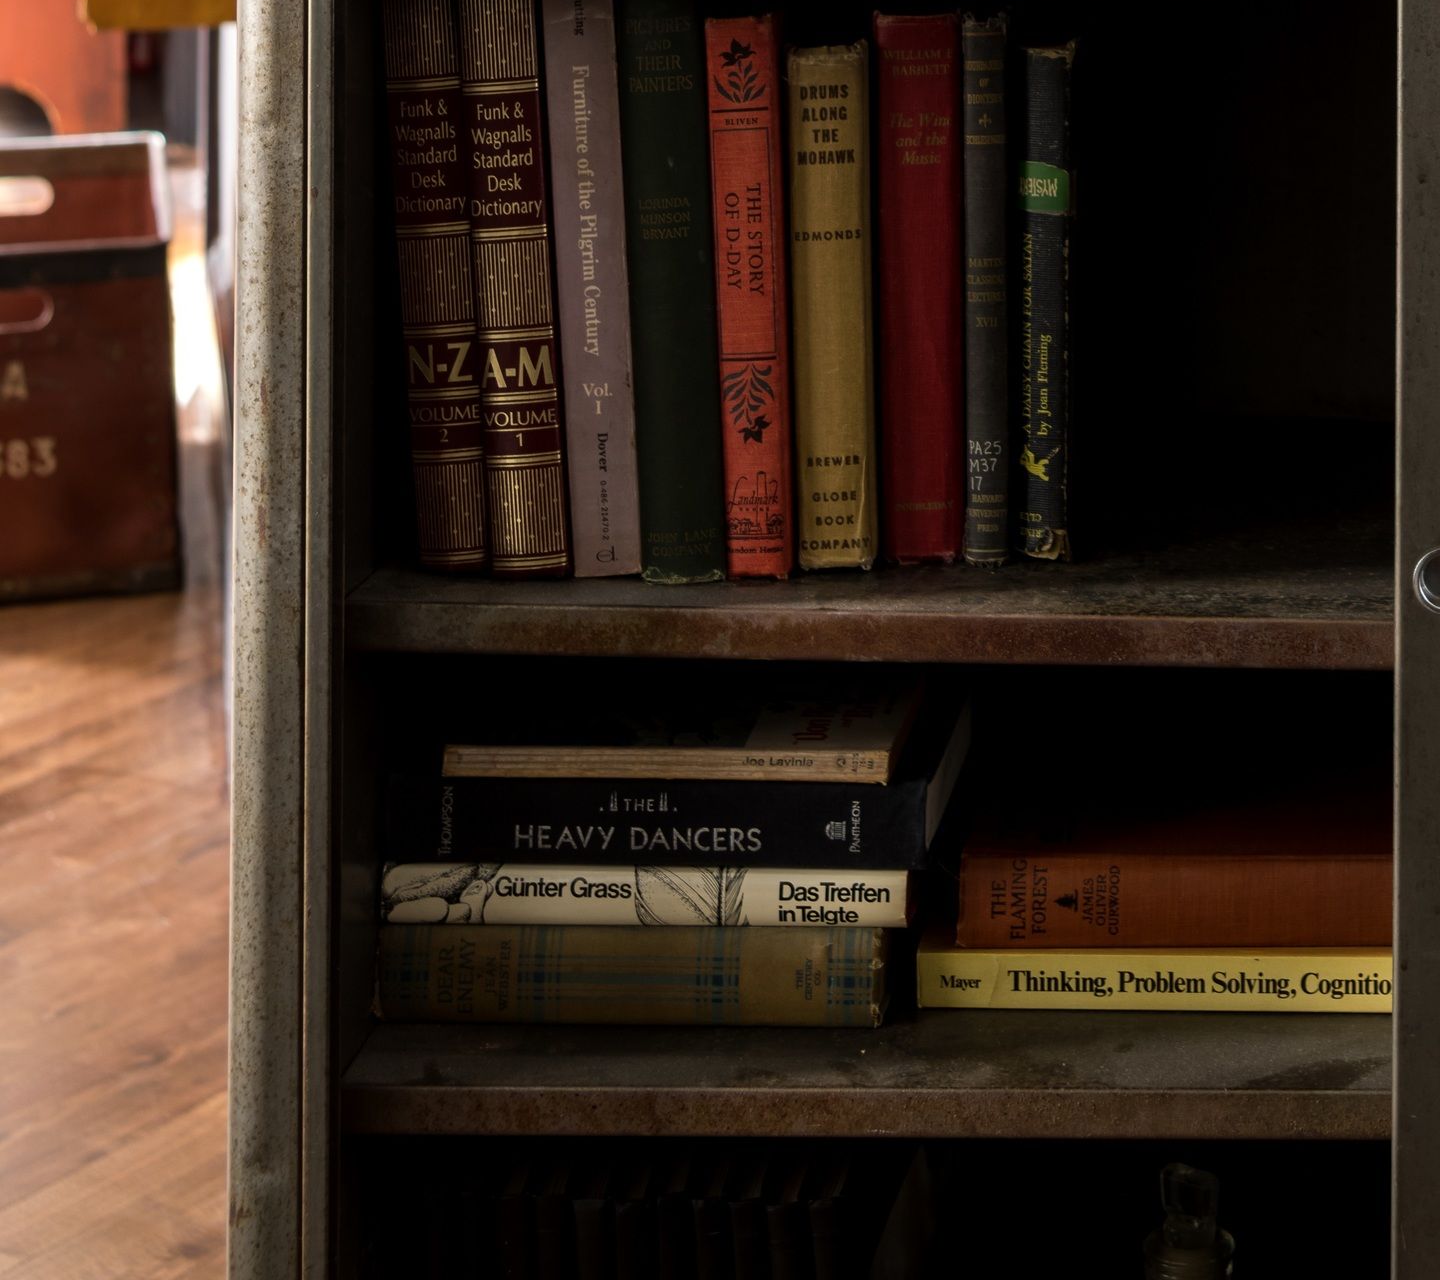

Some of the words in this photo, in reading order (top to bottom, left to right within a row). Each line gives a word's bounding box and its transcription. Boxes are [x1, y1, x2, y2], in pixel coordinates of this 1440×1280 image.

[625, 16, 691, 35] PICTURES
[645, 38, 672, 52] AND
[883, 48, 941, 60] WILLIAM
[636, 54, 683, 71] THEIR
[892, 63, 951, 76] BARRETT
[628, 74, 694, 93] PAINTERS
[800, 84, 850, 101] DRUMS
[400, 99, 433, 119] Funk
[437, 97, 448, 116] &
[476, 102, 509, 121] Funk
[513, 100, 525, 119] &
[571, 64, 592, 156] Furniture
[801, 106, 849, 122] ALONG
[724, 117, 759, 126] BLIVEN
[890, 111, 913, 128] The
[395, 122, 457, 146] Wagnalls
[471, 125, 533, 150] Wagnalls
[811, 128, 839, 143] THE
[895, 131, 922, 148] and
[926, 130, 947, 146] the
[397, 144, 458, 166] Standard
[473, 148, 534, 171] Standard
[797, 148, 856, 166] MOHAWK
[902, 151, 942, 165] Music
[577, 158, 595, 178] of
[410, 169, 447, 190] Desk
[487, 172, 522, 193] Desk
[395, 194, 467, 216] Dictionary
[577, 181, 598, 211] the
[724, 192, 740, 220] OF
[746, 182, 762, 224] THE
[471, 197, 543, 219] Dictionary
[639, 210, 691, 224] MUNSON
[641, 226, 690, 240] BRYANT
[793, 228, 862, 242] EDMONDS
[576, 214, 600, 282] Pilgrim
[725, 228, 742, 290] D-DAY
[1022, 232, 1033, 283] SATAN
[747, 231, 765, 296] STORY
[1022, 286, 1033, 316] FOR
[583, 285, 602, 358] Century
[1022, 321, 1033, 370] CHAIN
[408, 340, 473, 385] N-Z
[481, 344, 555, 389] A-M
[1037, 333, 1052, 384] Fleming
[581, 382, 614, 399] Vol.
[1022, 376, 1033, 418] DAISY
[1037, 388, 1051, 417] Joan
[408, 404, 480, 424] VOLUME
[484, 407, 557, 428] VOLUME
[439, 426, 449, 443] 2
[515, 431, 524, 448] 1
[1037, 420, 1052, 437] by
[597, 432, 608, 473] Dover
[969, 440, 1002, 455] PA25
[807, 455, 860, 467] BREWER
[969, 458, 998, 473] M37
[812, 490, 857, 502] GLOBE
[815, 515, 855, 526] BOOK
[801, 537, 871, 551] COMPANY
[742, 756, 765, 767] Joe
[623, 798, 656, 813] THE
[438, 784, 456, 858] THOMPSON
[848, 800, 861, 854] PANTHEON
[513, 824, 615, 851] HEAVY
[630, 827, 763, 853] DANCERS
[495, 876, 568, 898] Günter
[570, 878, 632, 900] Grass
[778, 881, 818, 902] Das
[819, 882, 891, 904] Treffen
[1010, 857, 1029, 941] FLAMING
[991, 879, 1008, 920] THE
[1030, 864, 1049, 936] FOREST
[1081, 878, 1094, 924] JAMES
[1095, 873, 1107, 929] OLIVER
[1108, 864, 1121, 936] CURWOOD
[778, 906, 793, 923] in
[796, 905, 859, 926] Telgte
[438, 944, 455, 1006] DEAR
[456, 939, 475, 1017] ENEMY
[485, 956, 497, 1000] JEAN
[499, 940, 512, 1011] WEBSTER
[939, 975, 982, 991] Mayer
[1007, 970, 1114, 998] Thinking,
[1117, 971, 1206, 994] Problem
[1211, 971, 1297, 1001] Solving,
